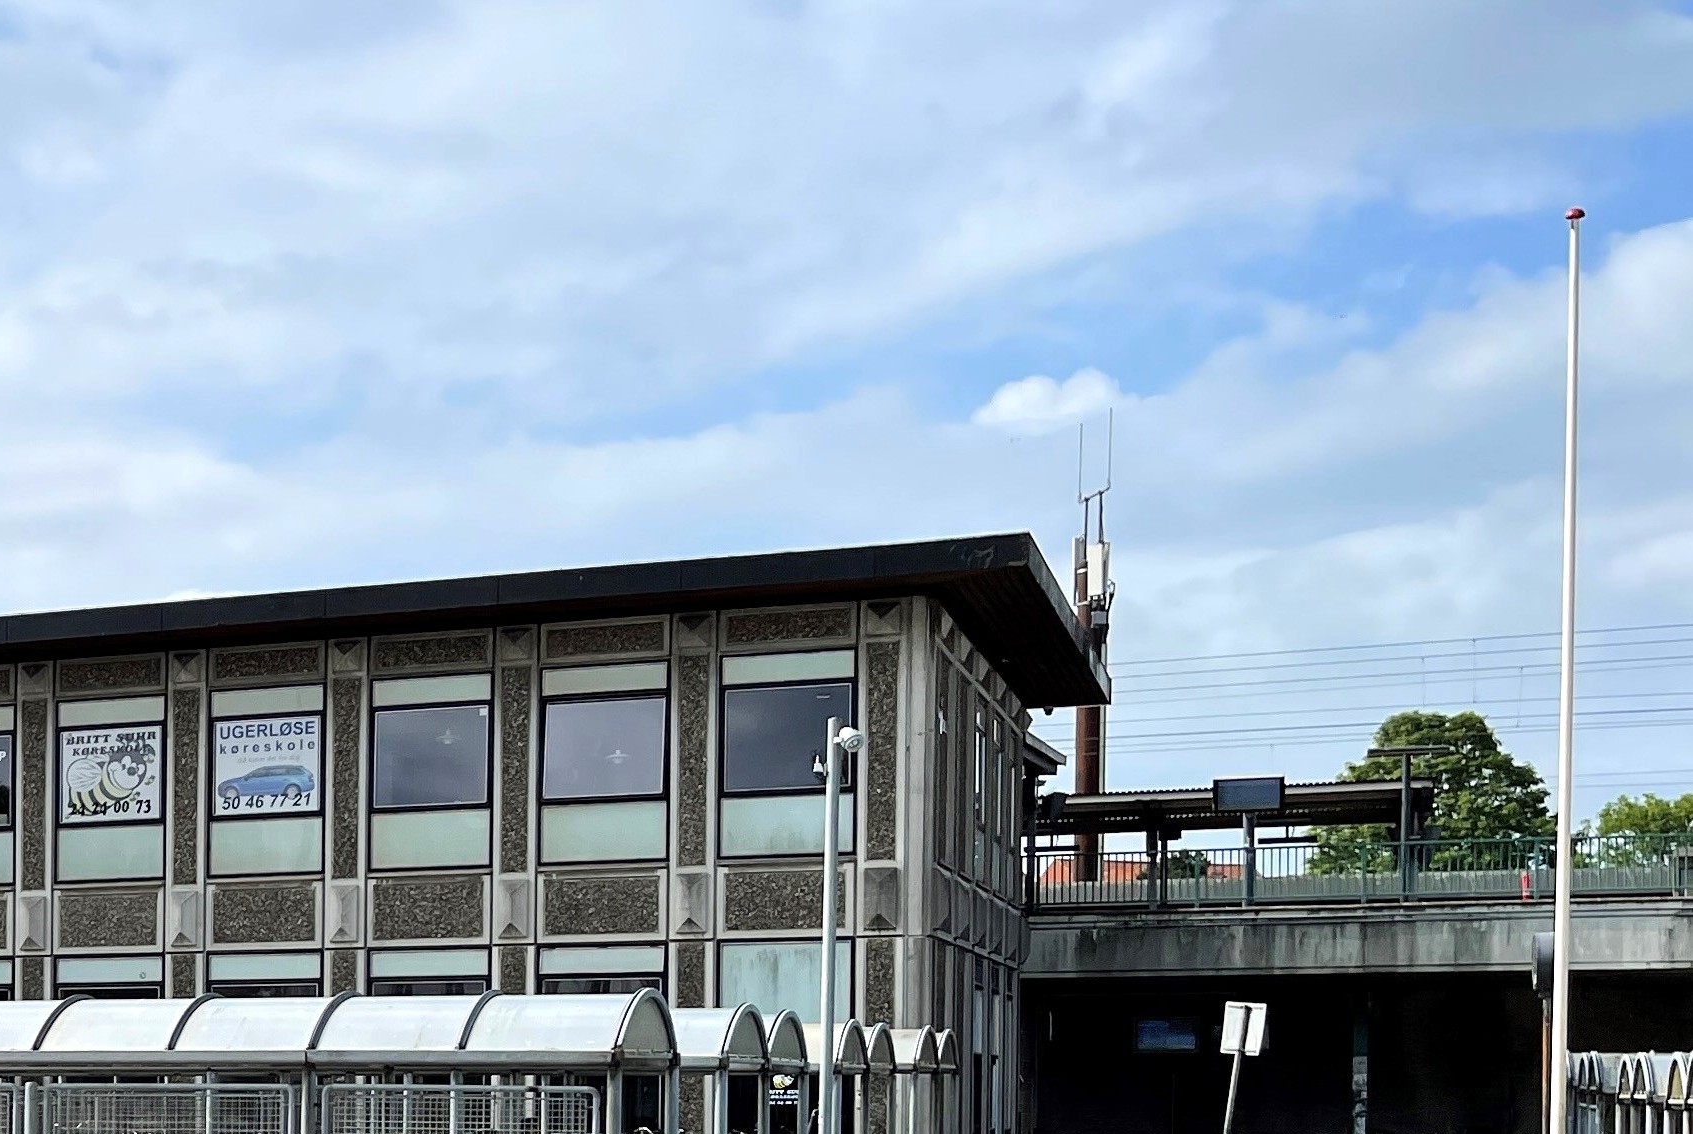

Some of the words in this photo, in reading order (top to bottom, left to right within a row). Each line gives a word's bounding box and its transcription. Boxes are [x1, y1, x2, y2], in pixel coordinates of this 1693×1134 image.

[220, 721, 316, 739] UGERLØSE
[67, 735, 111, 745] BRITT
[219, 739, 316, 754] køreskole
[113, 800, 130, 813] 00
[135, 799, 151, 813] 73
[221, 795, 241, 810] 50
[245, 794, 264, 808] 46
[269, 793, 288, 807] 77
[292, 792, 311, 807] 21
